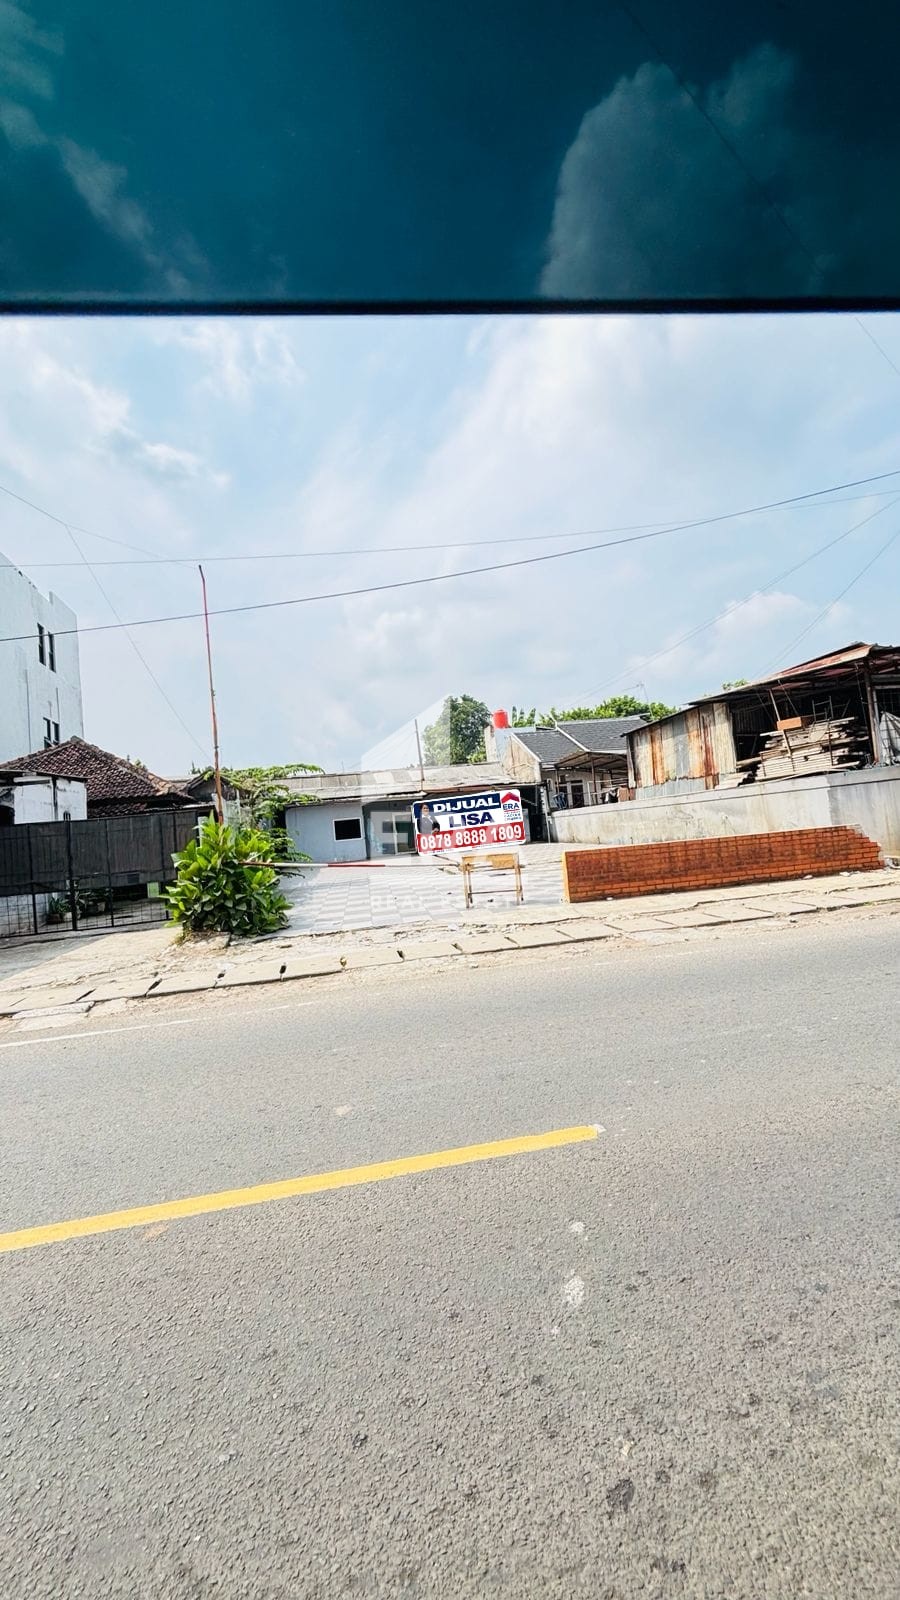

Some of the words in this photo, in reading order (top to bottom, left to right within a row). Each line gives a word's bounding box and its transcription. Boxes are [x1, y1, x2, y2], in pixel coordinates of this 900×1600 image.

[432, 797, 500, 813] DIJUAL
[503, 803, 520, 811] ERA
[449, 812, 495, 828] LISA
[420, 833, 451, 850] 0878
[455, 829, 487, 845] 8888
[491, 825, 522, 841] 1809
